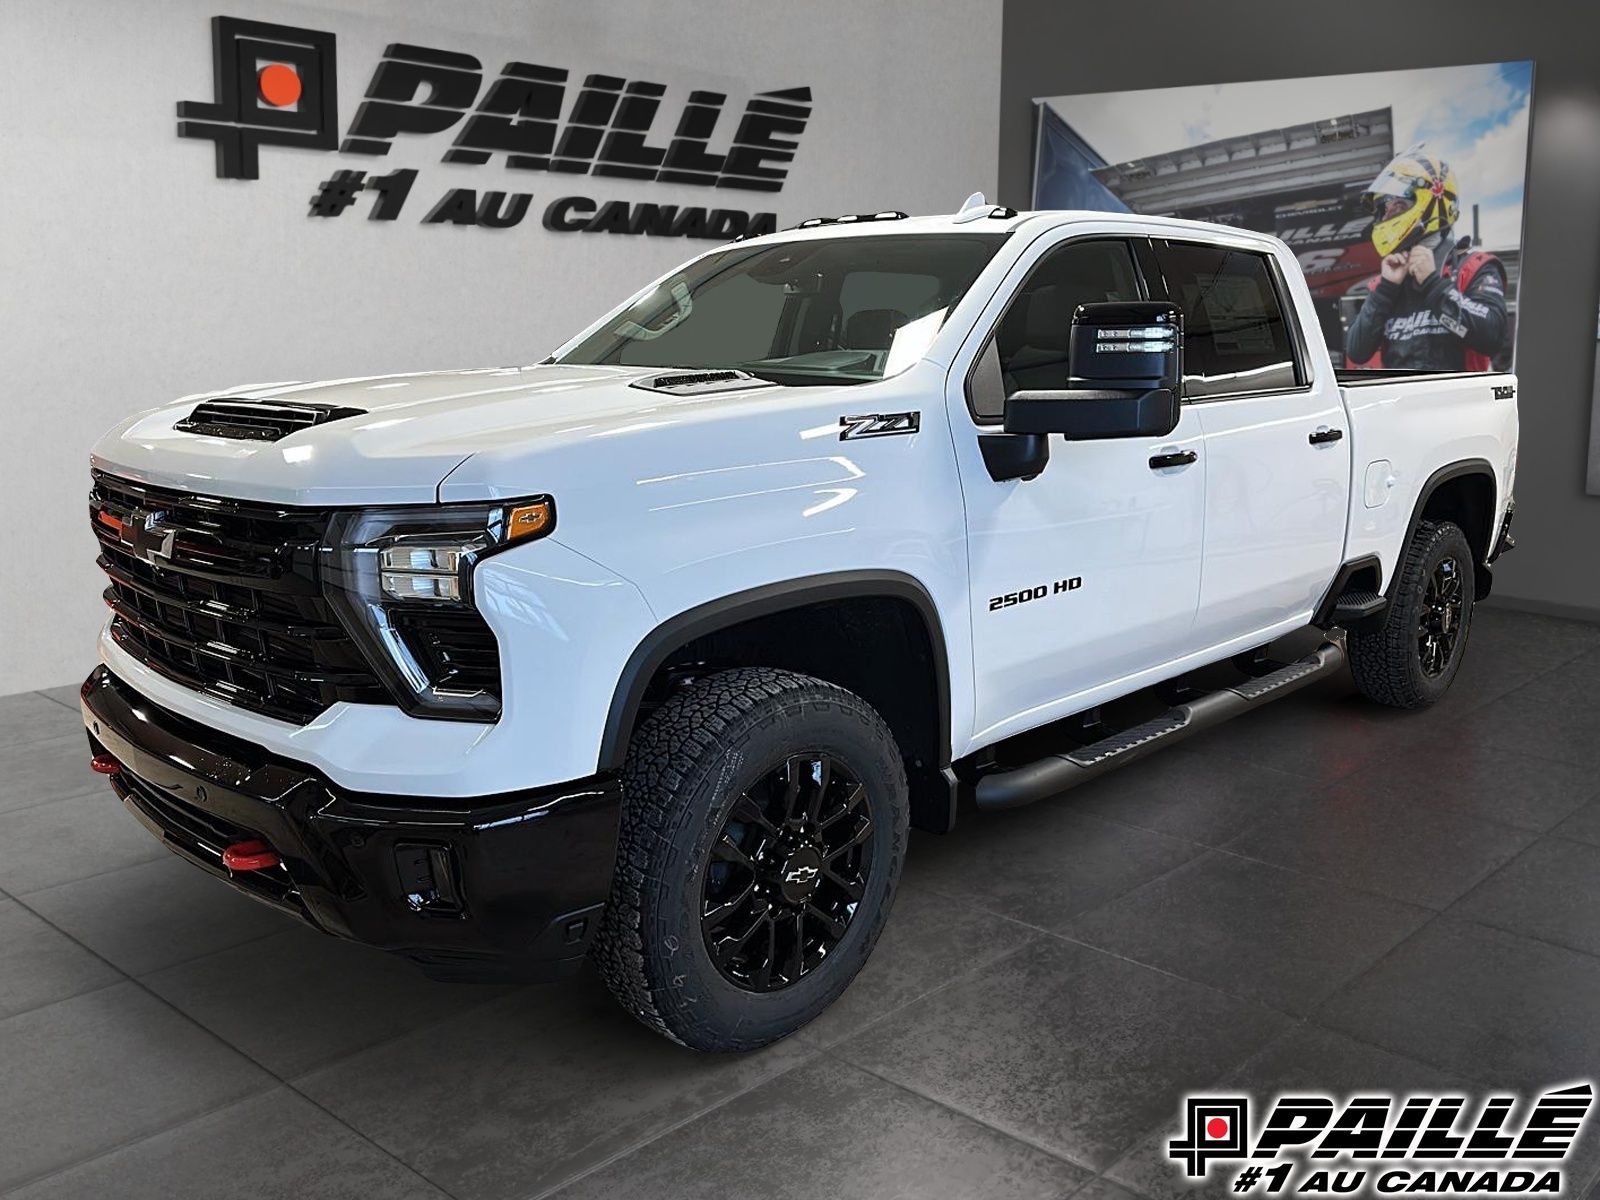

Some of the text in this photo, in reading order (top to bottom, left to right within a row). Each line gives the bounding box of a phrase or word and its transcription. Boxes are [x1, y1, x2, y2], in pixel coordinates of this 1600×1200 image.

[339, 43, 812, 192] PAILLÉ
[308, 168, 777, 240] #1 AU CANADA
[839, 411, 921, 441] Z71
[989, 577, 1082, 611] 2500 HD
